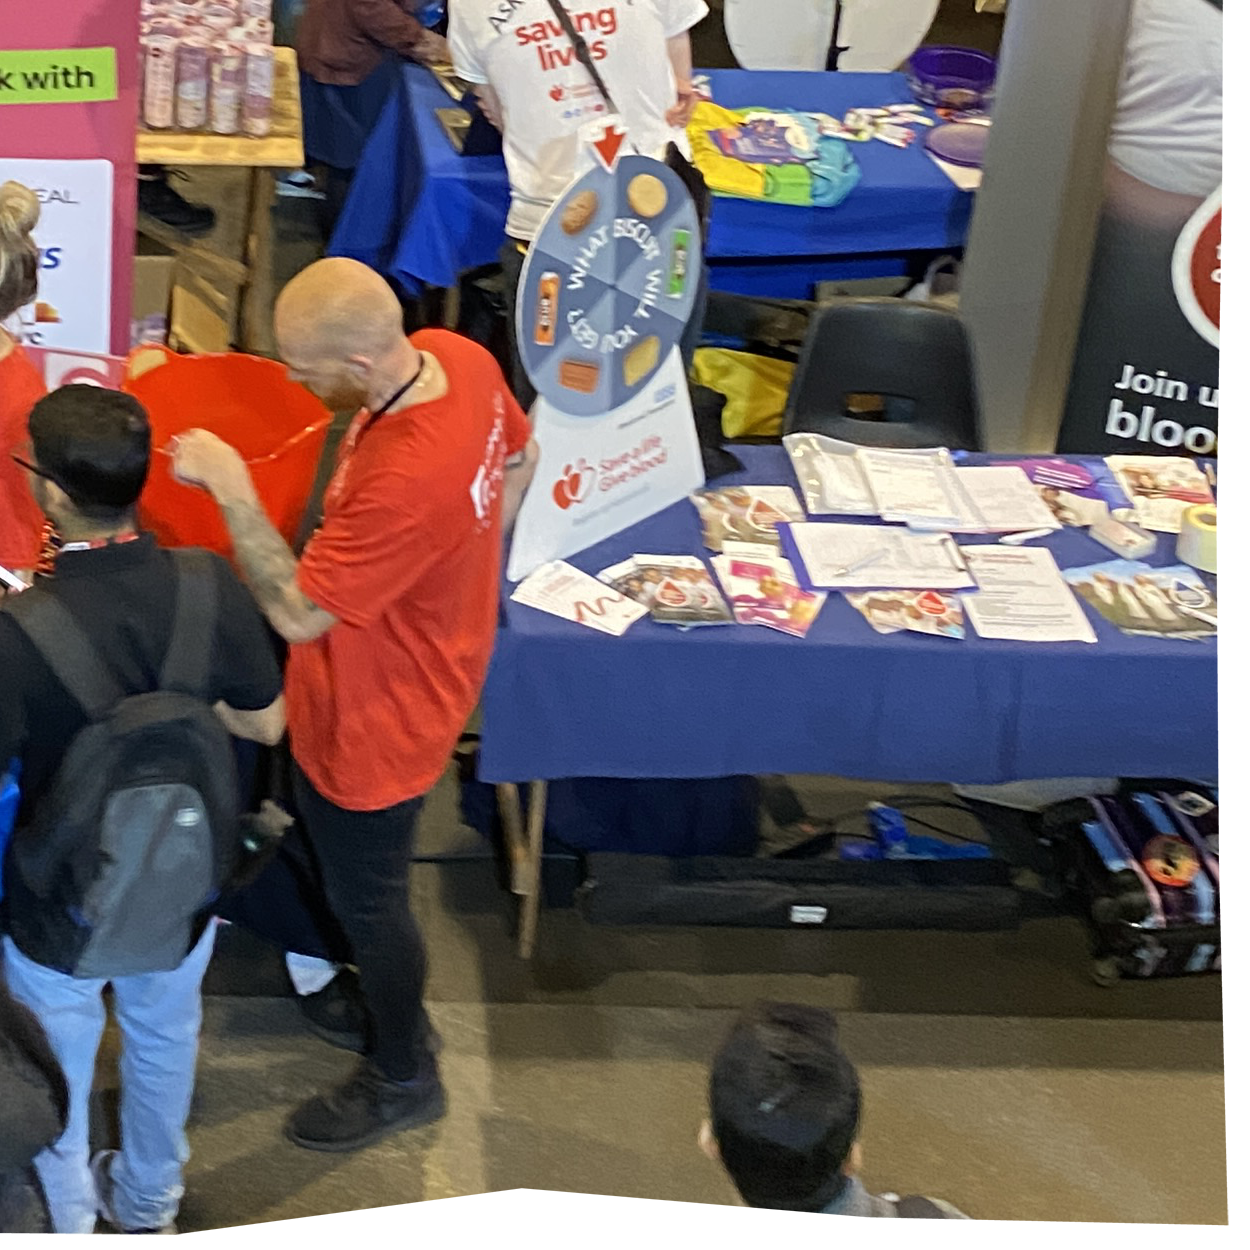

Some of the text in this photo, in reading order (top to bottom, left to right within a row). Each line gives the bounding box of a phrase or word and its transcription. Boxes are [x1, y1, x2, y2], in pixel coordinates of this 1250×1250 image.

[514, 6, 617, 47] savng
[535, 38, 608, 71] livs
[20, 64, 95, 92] with
[566, 224, 610, 291] WHAT
[612, 217, 661, 261] BISCUIT
[632, 268, 662, 320] WILL
[602, 323, 639, 353] YOU
[1114, 364, 1188, 401] Join
[599, 452, 630, 476] Save
[640, 434, 664, 455] life
[599, 447, 669, 492] Give blood
